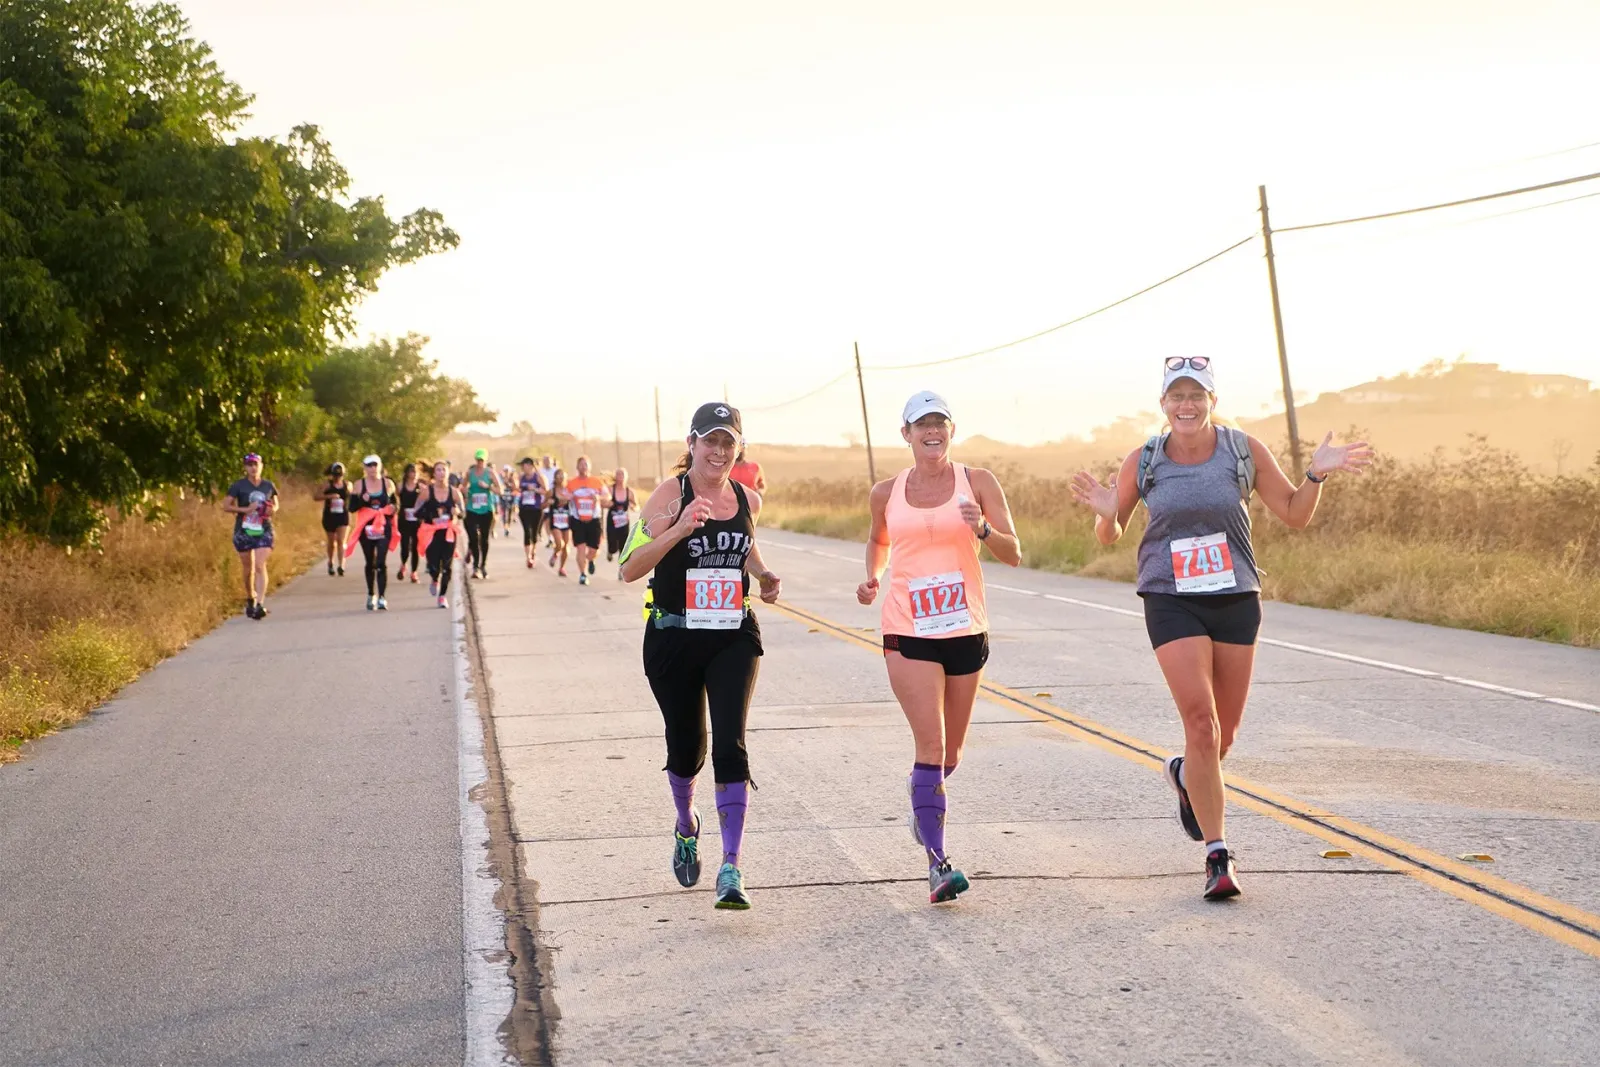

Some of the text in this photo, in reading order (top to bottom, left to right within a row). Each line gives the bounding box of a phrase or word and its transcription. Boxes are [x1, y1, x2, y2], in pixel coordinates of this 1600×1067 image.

[688, 531, 753, 557] SLOTH
[1180, 545, 1224, 577] 749
[695, 581, 736, 609] 832
[912, 584, 965, 617] 1122
